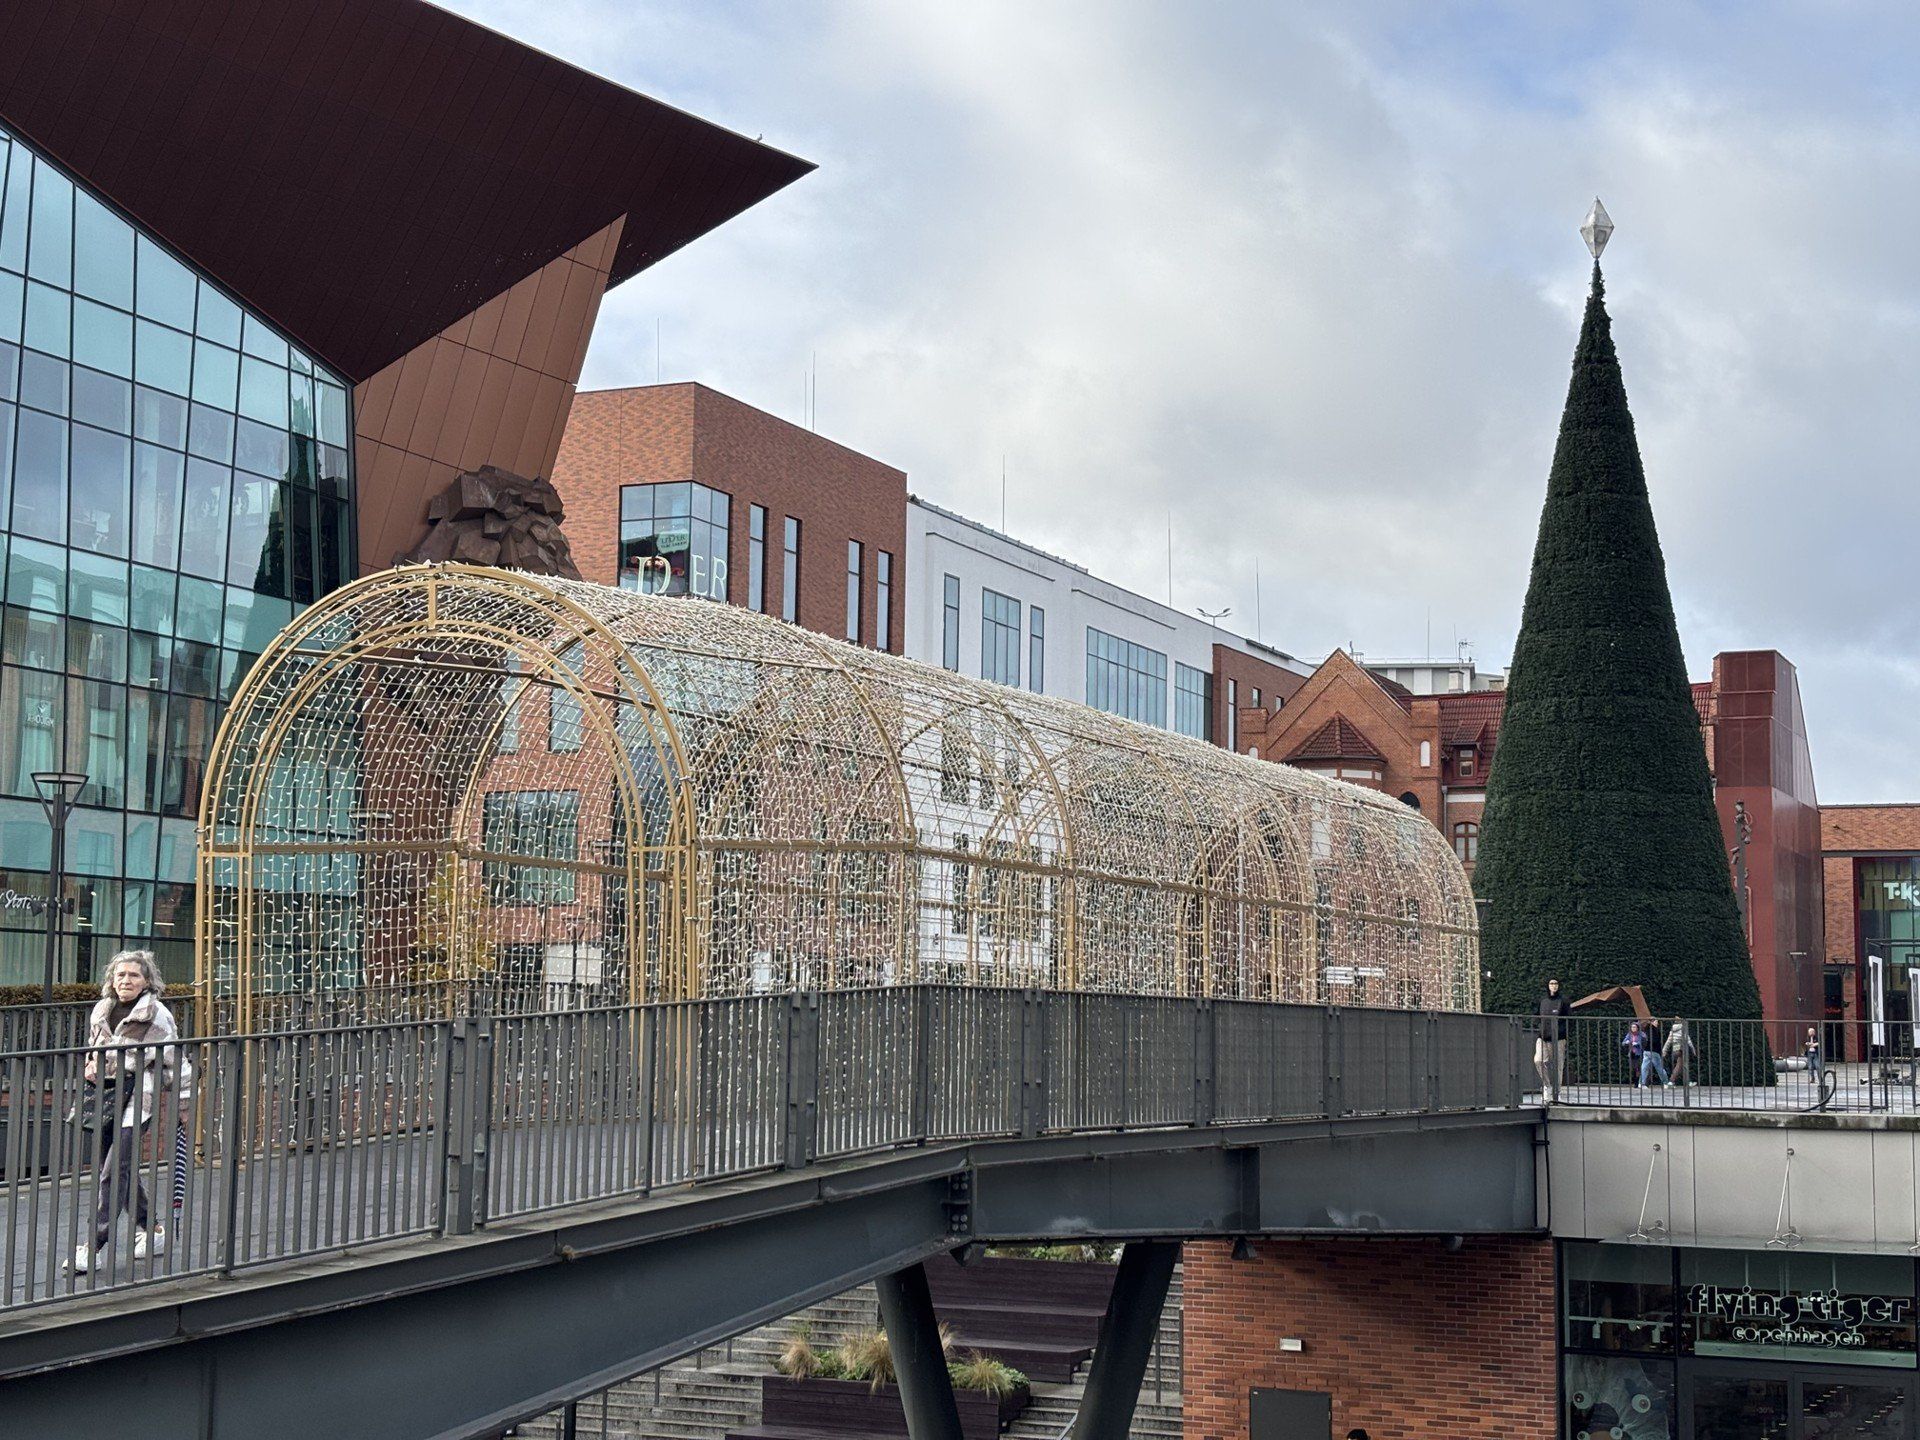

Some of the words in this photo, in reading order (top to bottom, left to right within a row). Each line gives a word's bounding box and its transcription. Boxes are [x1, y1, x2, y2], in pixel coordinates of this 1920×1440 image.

[1687, 1283, 1800, 1326] flying
[1808, 1288, 1911, 1329] tiger
[1732, 1326, 1866, 1349] copenhagen
